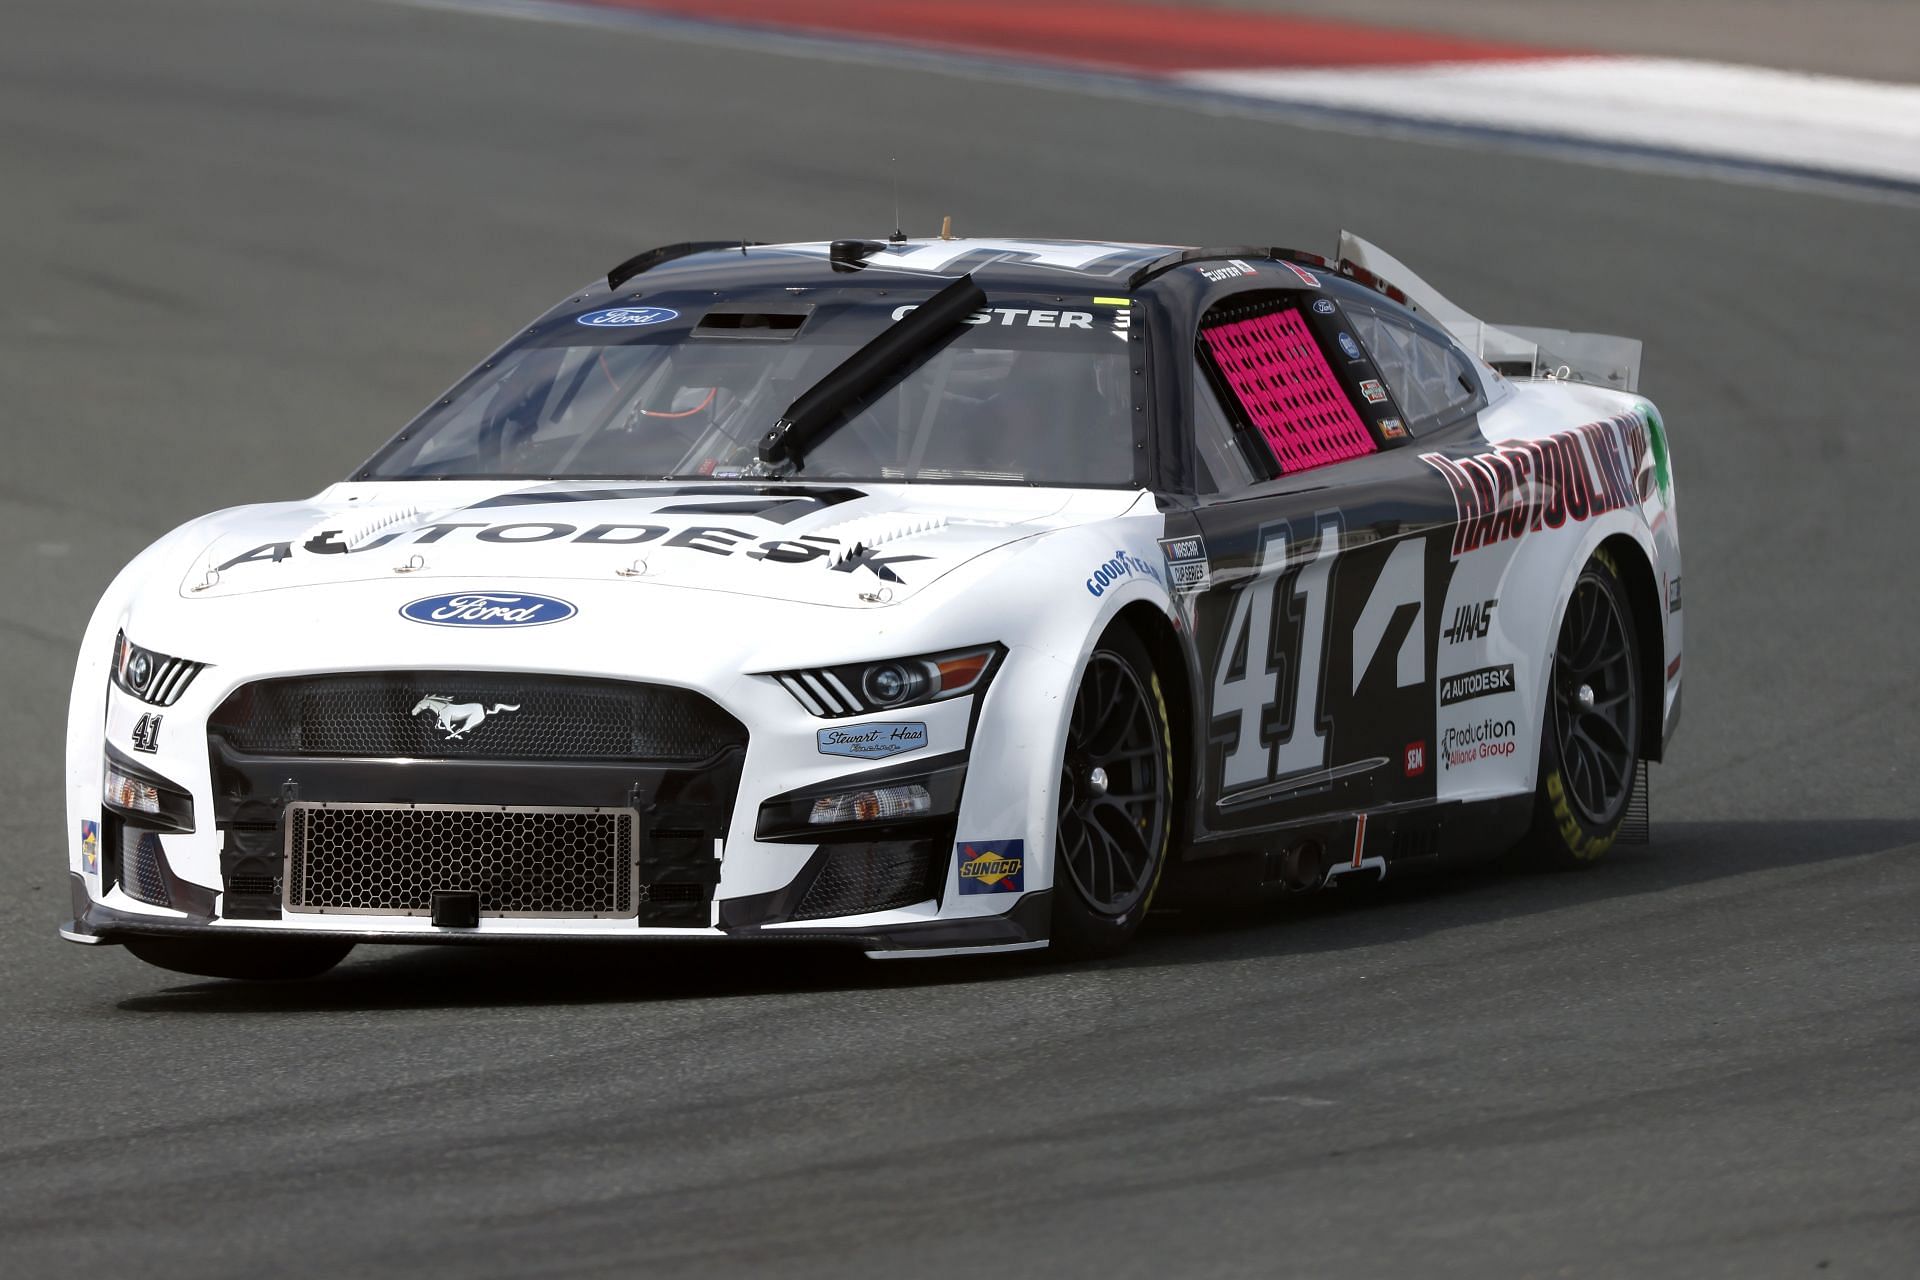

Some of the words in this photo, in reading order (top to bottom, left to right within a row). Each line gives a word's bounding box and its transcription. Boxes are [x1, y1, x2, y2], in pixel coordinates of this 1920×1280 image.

[593, 308, 662, 324] Ford
[891, 304, 1094, 329] CSTER
[215, 522, 938, 586] AUTODESK
[1174, 540, 1199, 559] NASCAR
[1184, 564, 1204, 581] SERIES
[431, 595, 546, 623] Ford
[1443, 599, 1499, 645] HAAS
[1211, 512, 1343, 794] 41
[1452, 668, 1511, 699] AUTODESK
[132, 712, 163, 755] 41
[1449, 718, 1516, 747] Production
[1407, 747, 1423, 771] SEM
[1449, 747, 1477, 768] Alliance
[1479, 741, 1516, 759] Group
[962, 860, 1019, 876] SUNOCO
